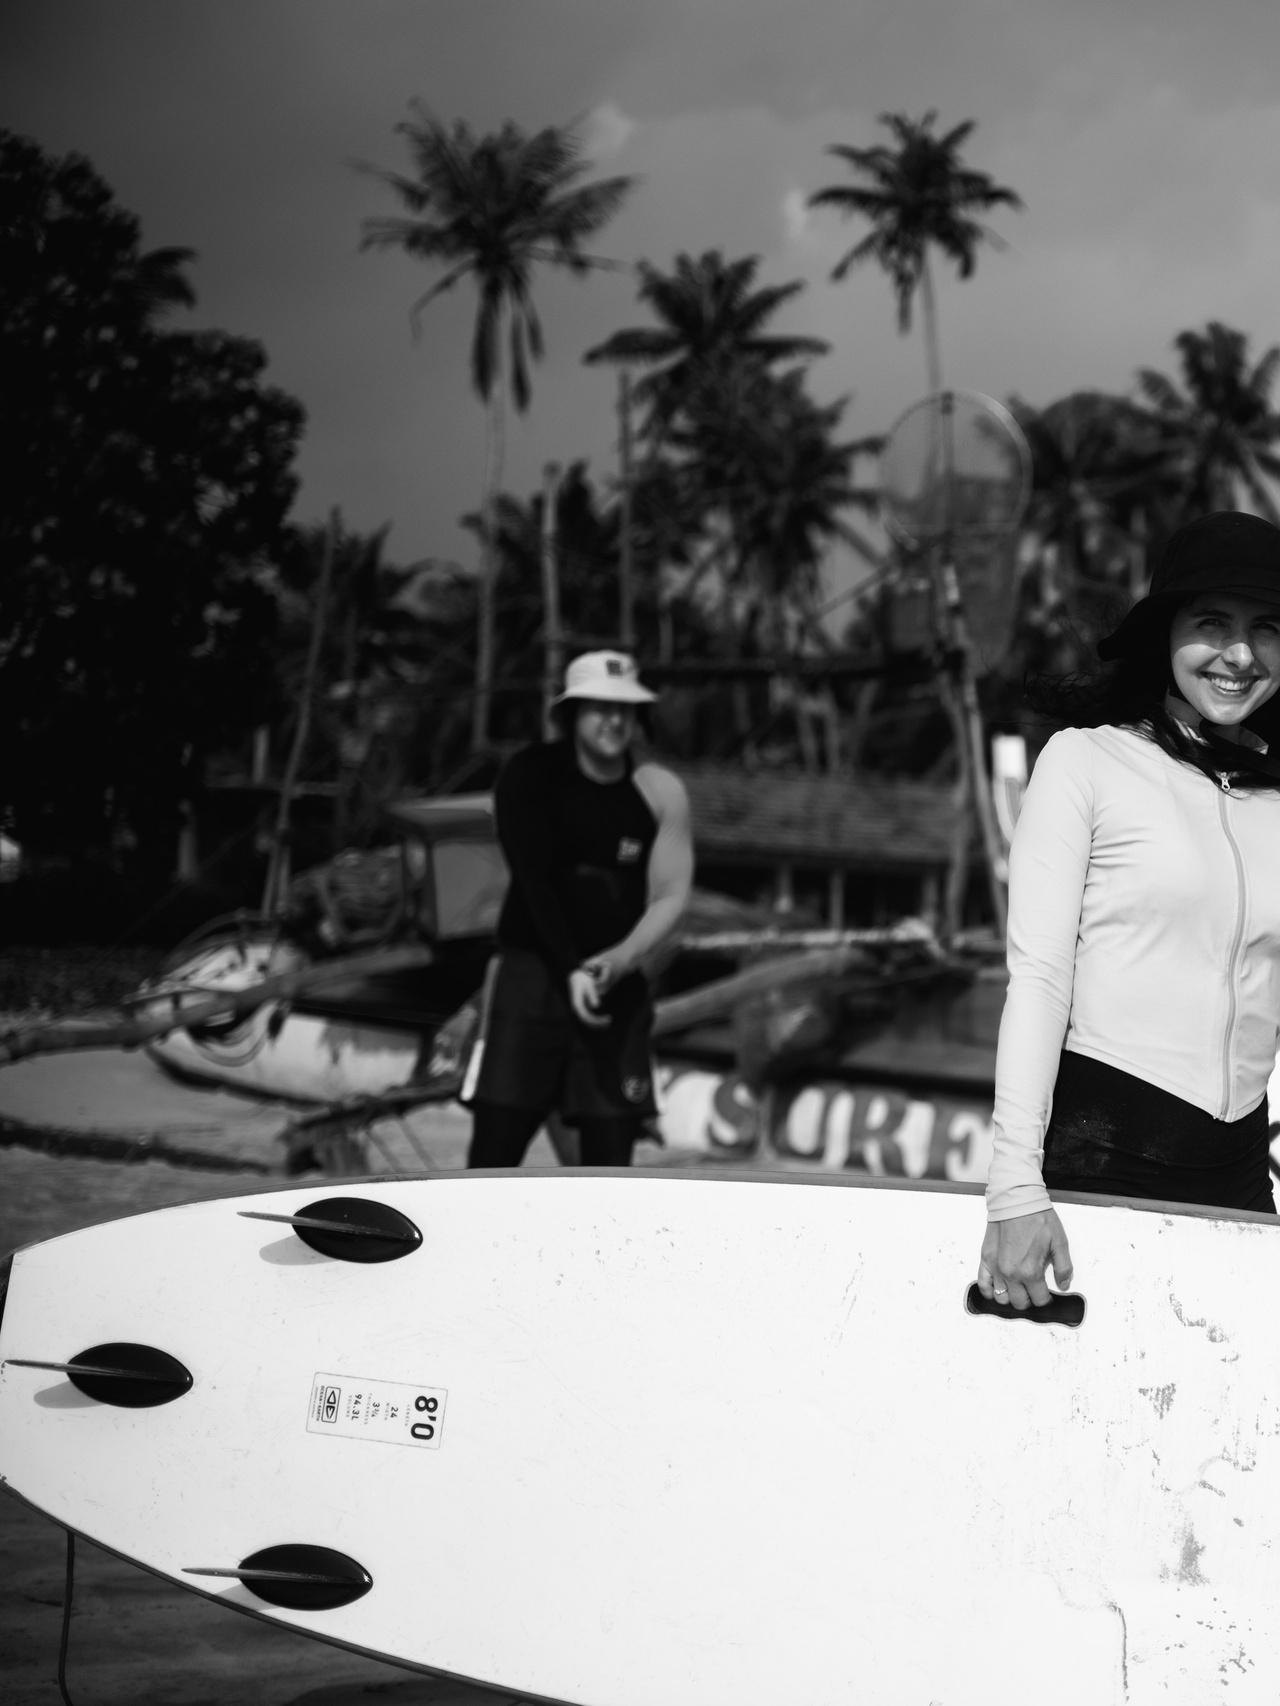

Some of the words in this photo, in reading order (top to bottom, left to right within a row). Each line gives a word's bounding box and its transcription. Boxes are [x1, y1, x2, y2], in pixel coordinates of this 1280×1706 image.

[351, 1393, 363, 1421] 94.3L
[363, 1393, 373, 1425] THICKNESS
[389, 1406, 399, 1418] 24
